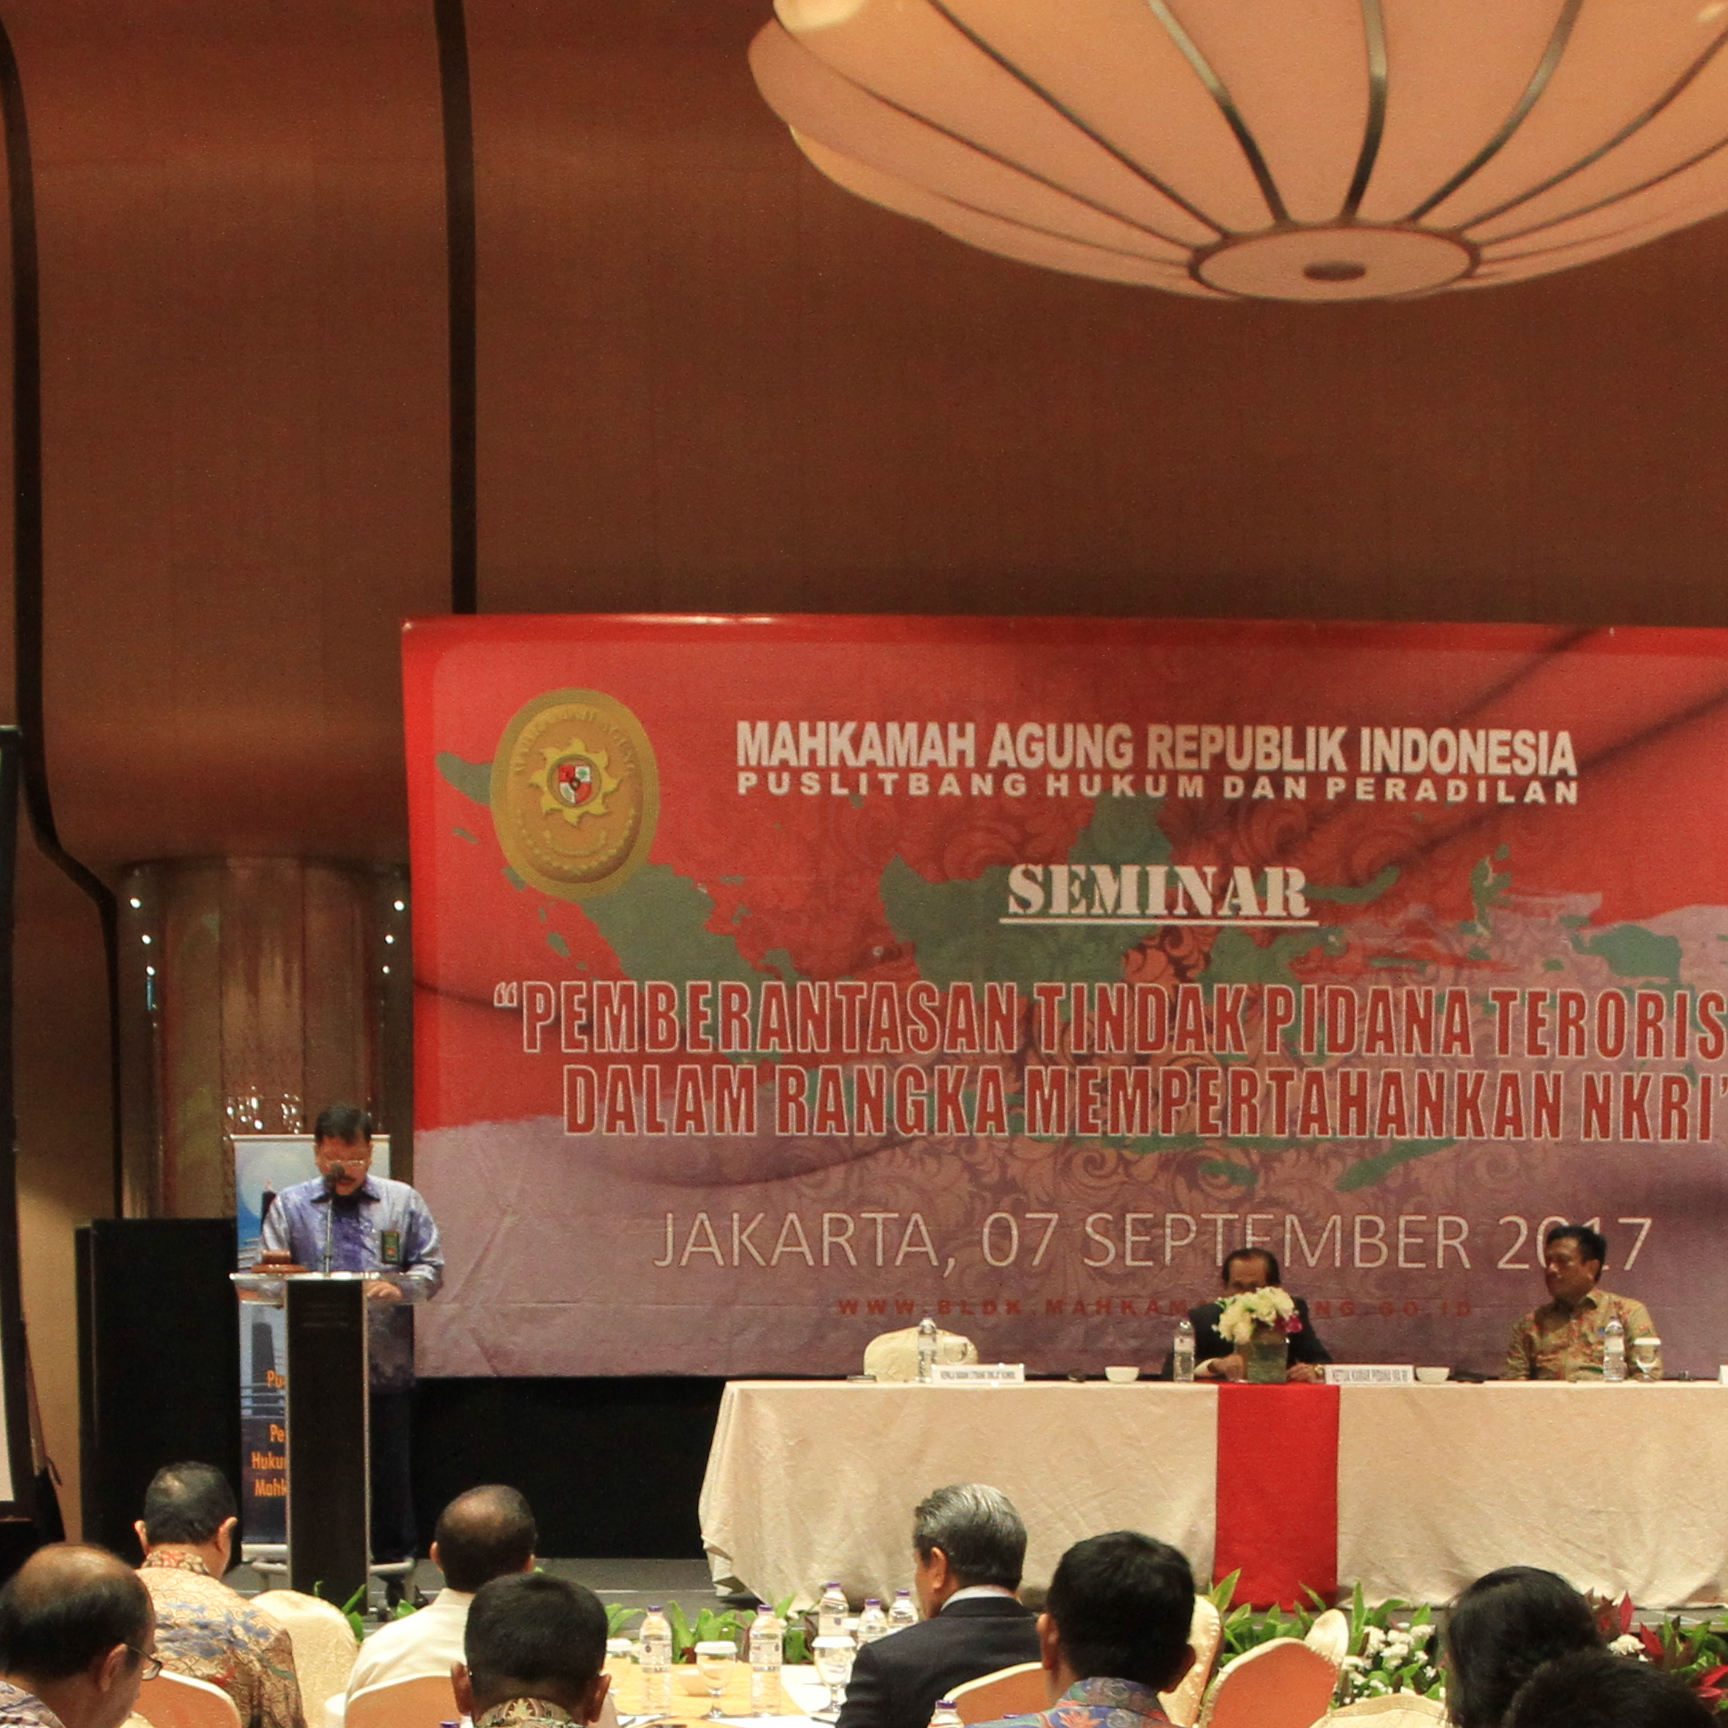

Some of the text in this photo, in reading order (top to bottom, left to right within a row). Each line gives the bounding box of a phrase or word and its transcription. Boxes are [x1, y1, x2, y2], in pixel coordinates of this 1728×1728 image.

[736, 720, 1578, 777] MAHKAMAH AGUNG REPUBLIK INDONESIA
[736, 774, 1579, 805] PUSLITBANG HUKUM DAN PERADILAN
[1007, 862, 1311, 918] SEMINAR
[1033, 982, 1249, 1055] TINDAK
[1262, 984, 1474, 1057] PIDANA
[563, 1064, 759, 1136] DALAM
[774, 1065, 1009, 1137] RANGKA
[1023, 1065, 1564, 1141] MEMPERTAHANKAN
[653, 1211, 957, 1278] JAKARTA,
[980, 1211, 1060, 1268] 07
[1083, 1211, 1472, 1271] SEPTEMBER
